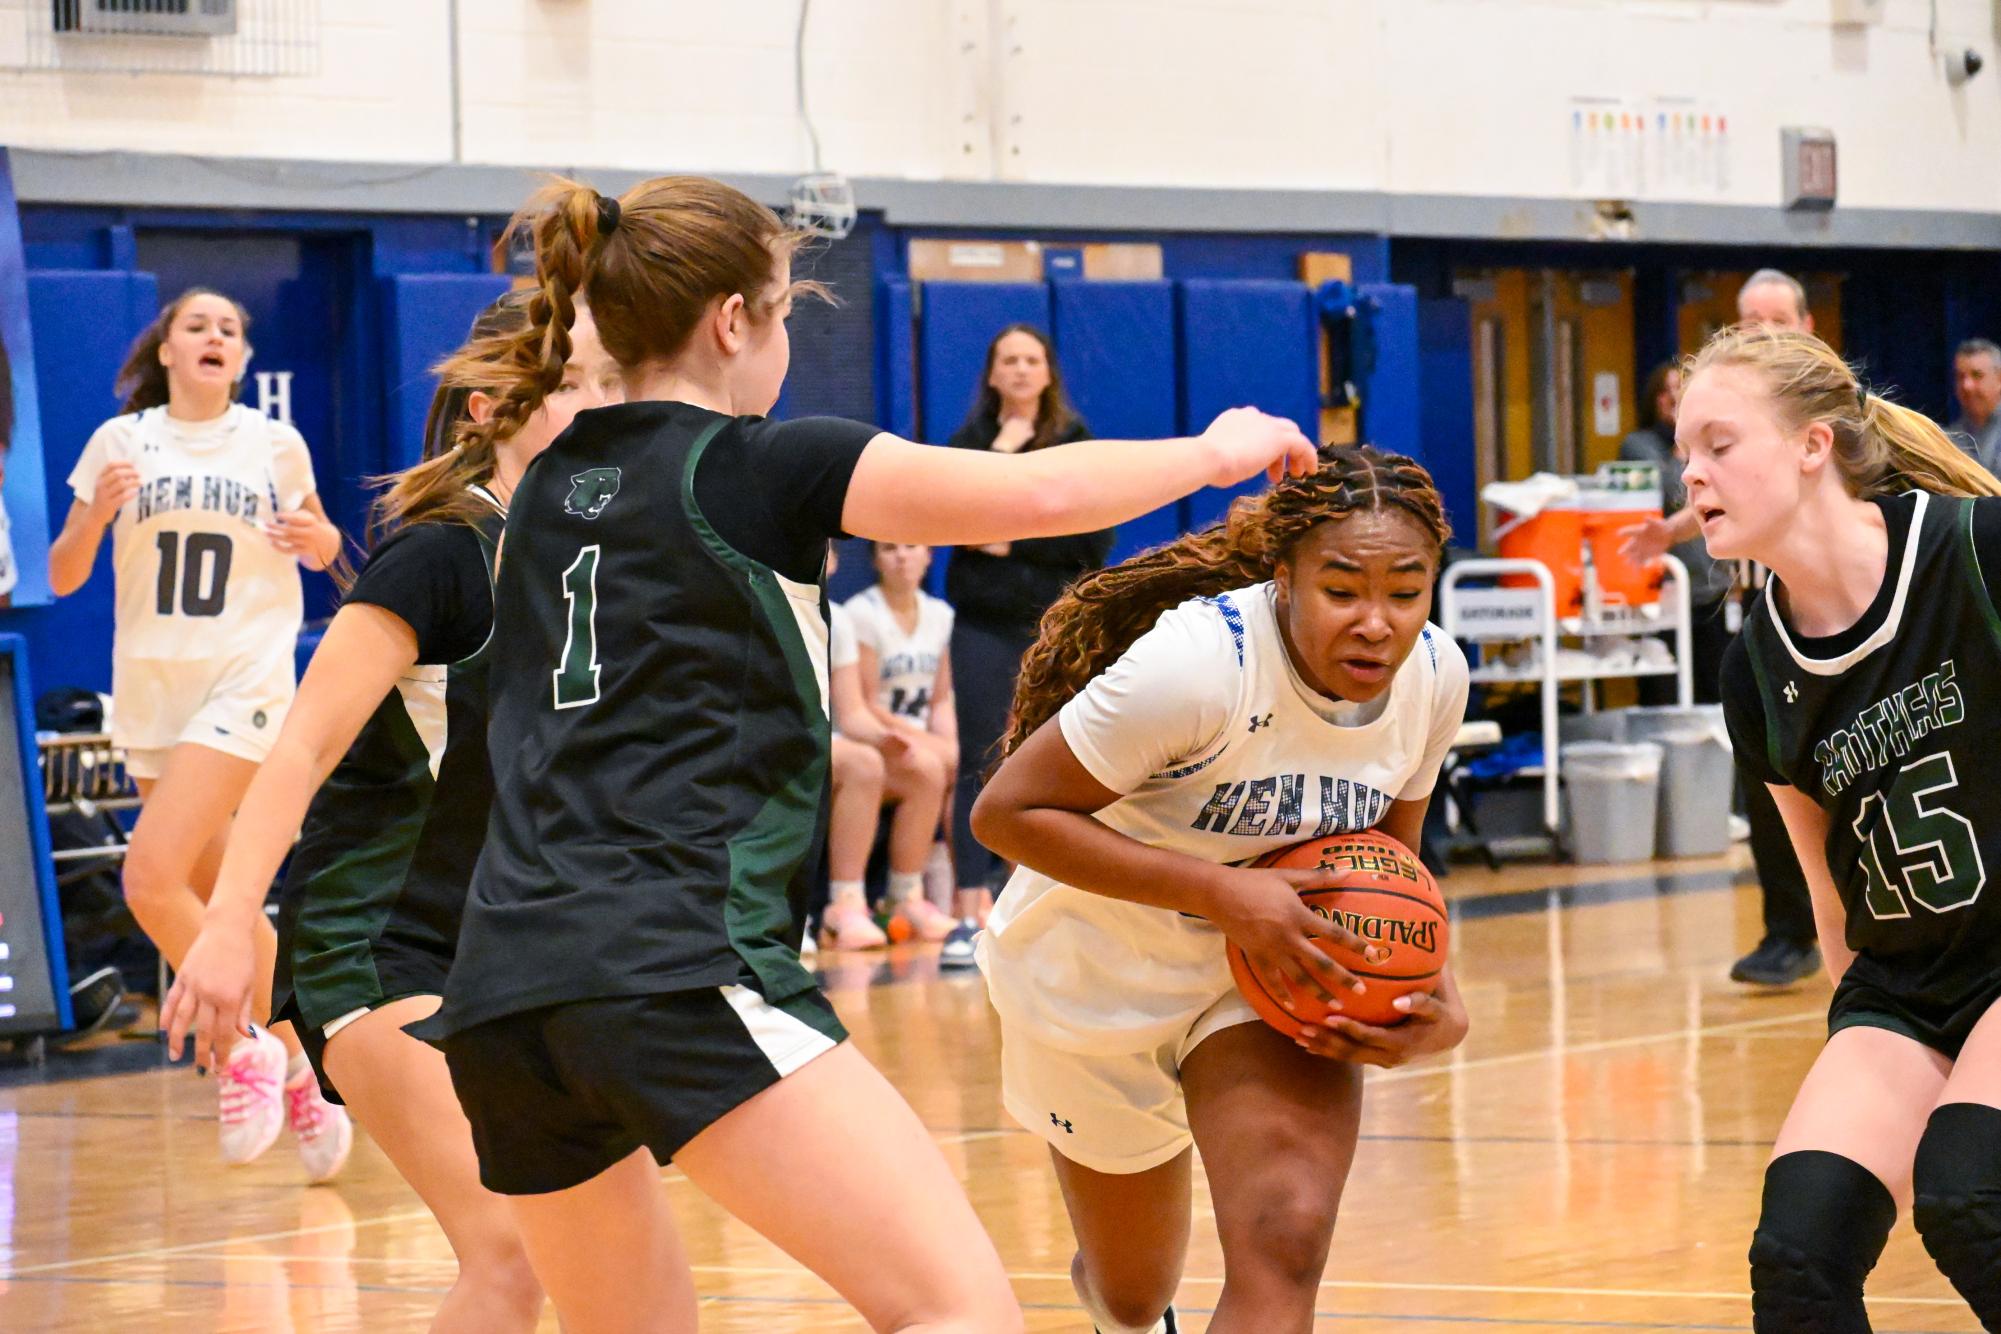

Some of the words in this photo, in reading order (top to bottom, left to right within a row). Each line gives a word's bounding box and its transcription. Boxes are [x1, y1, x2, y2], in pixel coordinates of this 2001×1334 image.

[136, 476, 192, 524] HEN
[156, 530, 233, 616] 10
[553, 544, 602, 710] 1
[1190, 774, 1305, 837] HEN
[1852, 750, 1987, 920] 15
